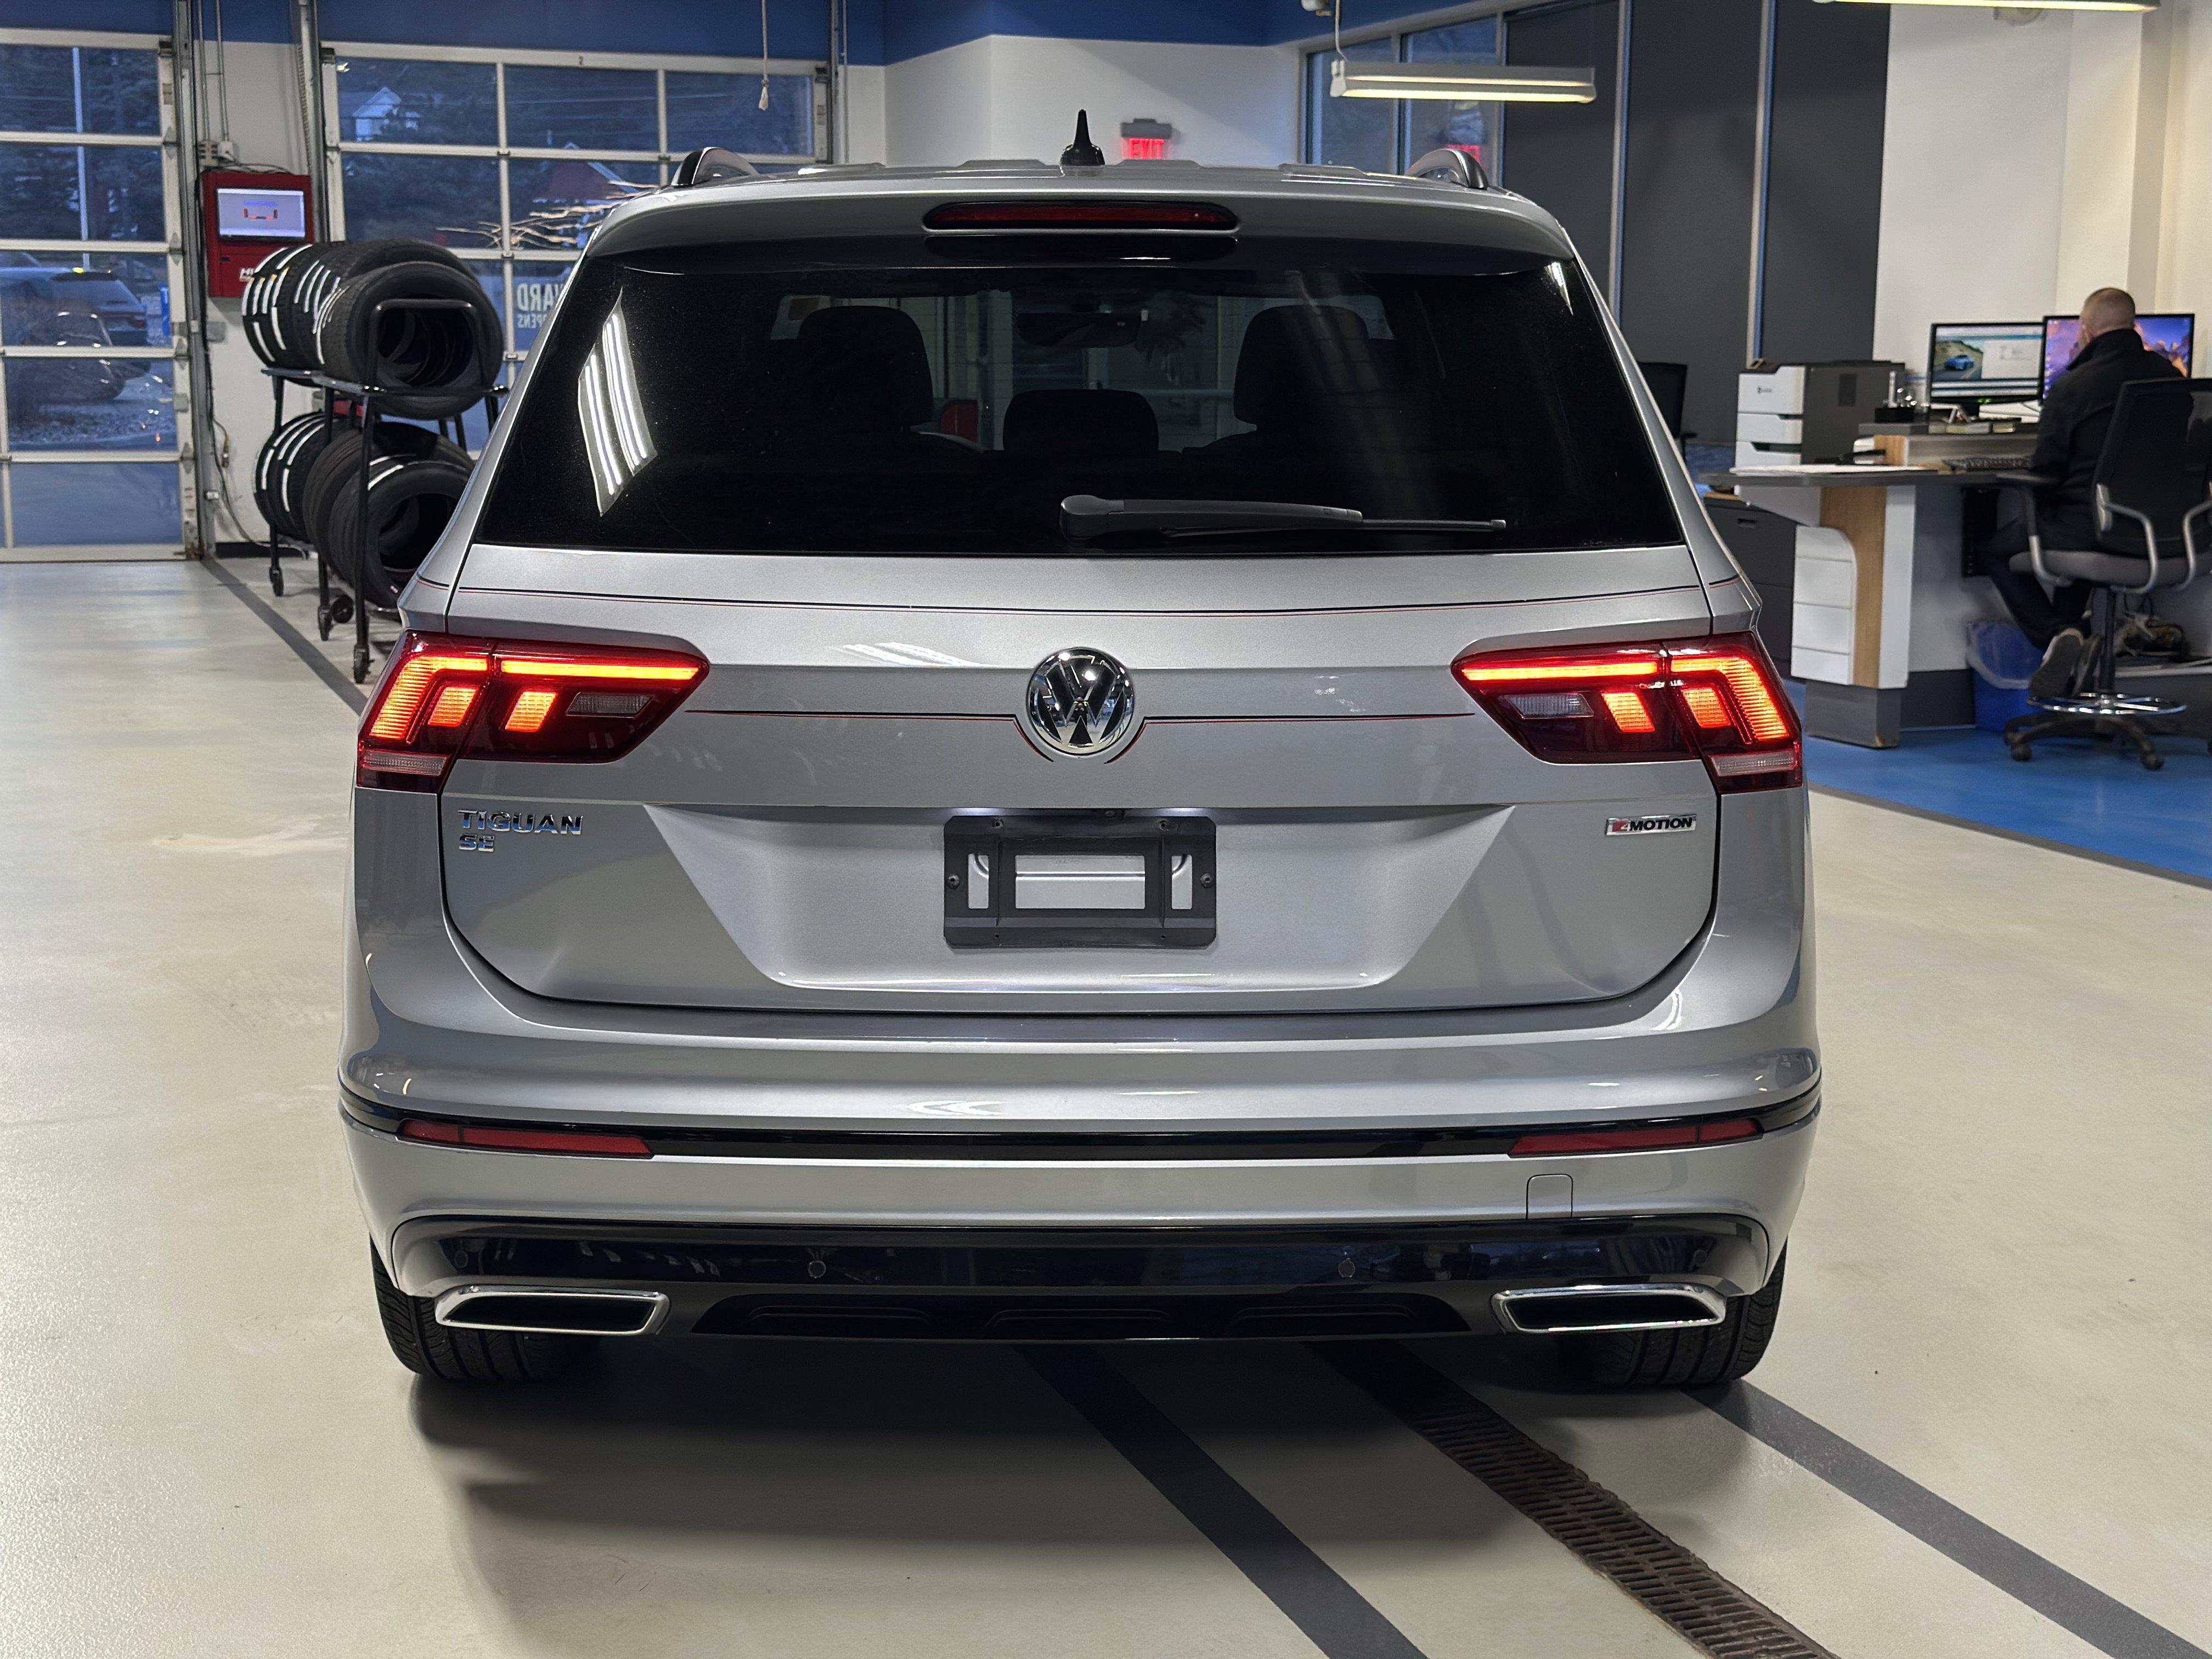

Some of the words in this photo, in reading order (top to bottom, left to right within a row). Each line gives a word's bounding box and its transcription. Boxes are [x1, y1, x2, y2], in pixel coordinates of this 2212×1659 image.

[1130, 138, 1164, 159] EXIT
[458, 809, 584, 835] TIGUAN
[1612, 817, 1693, 833] 4MOTION
[459, 834, 495, 852] SE
